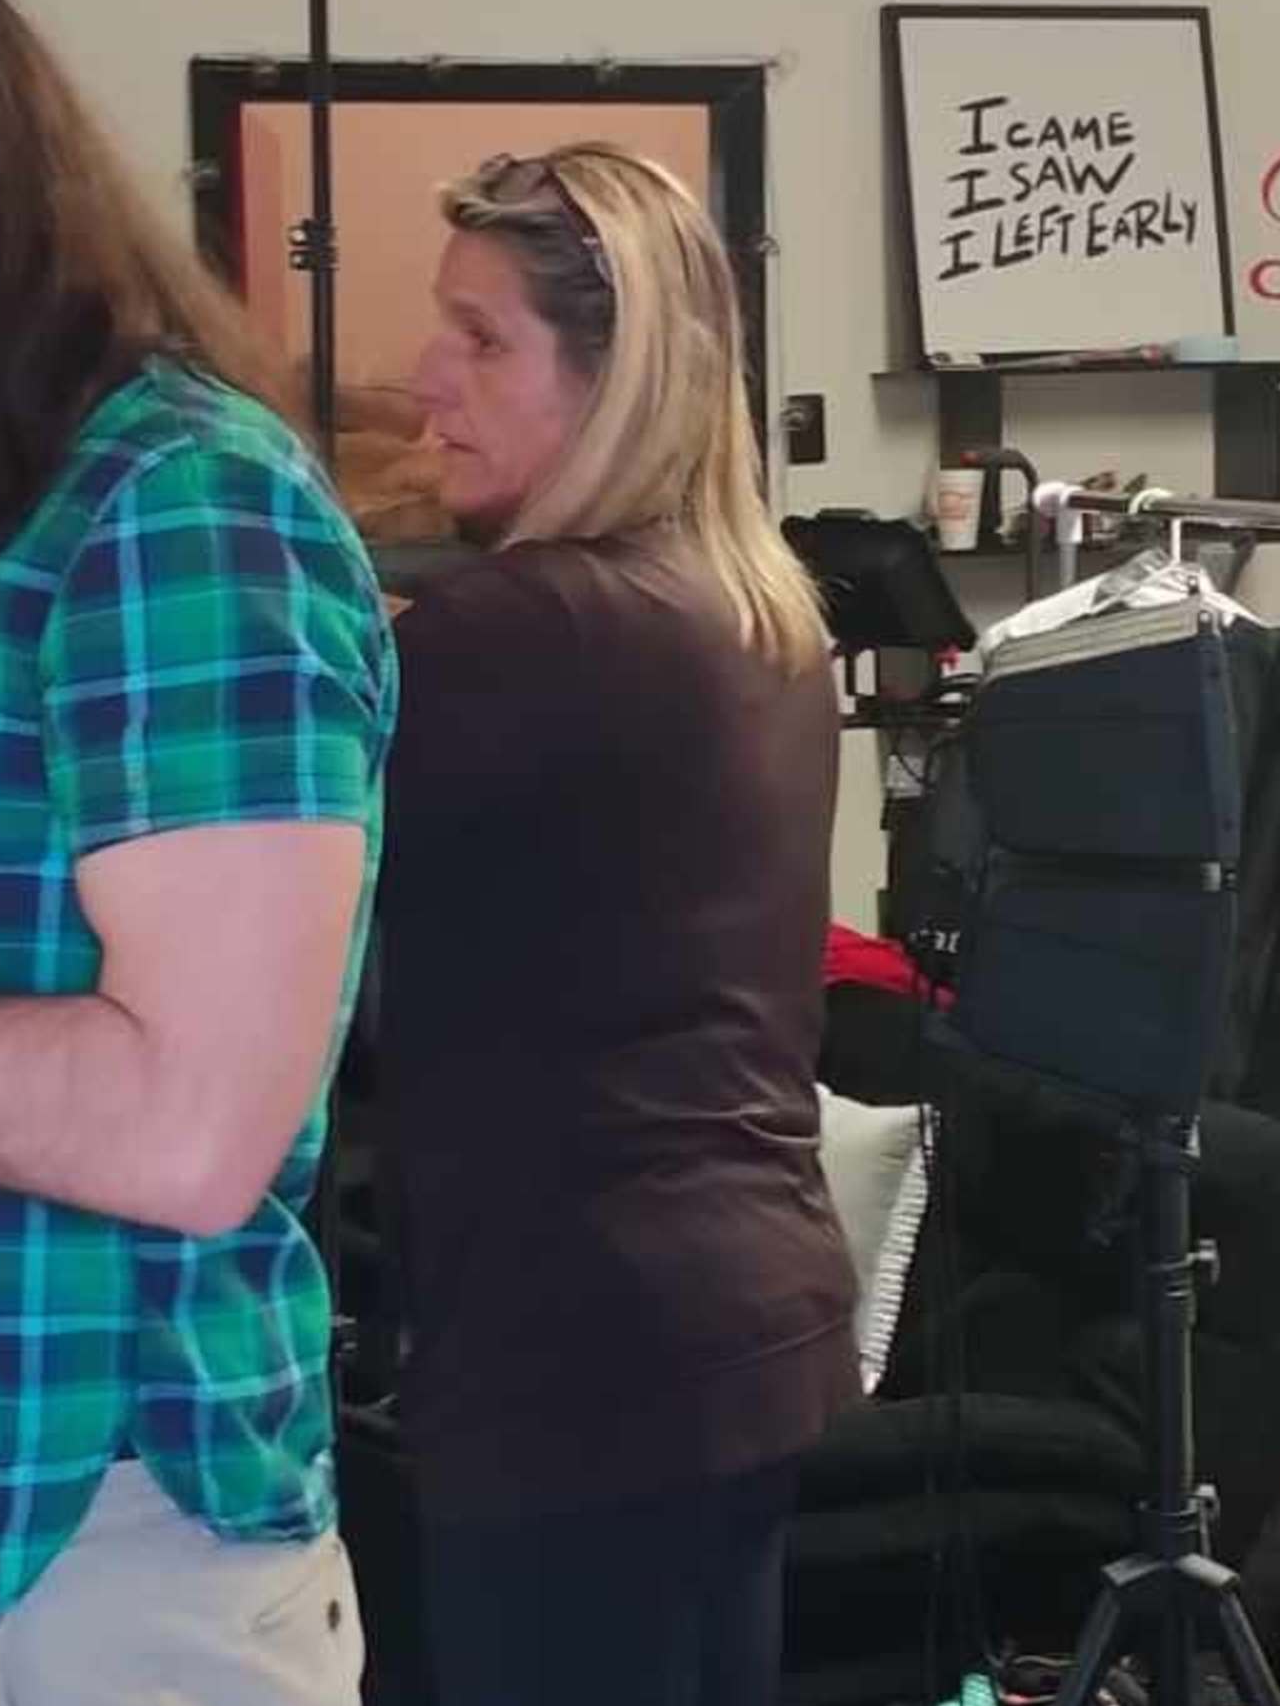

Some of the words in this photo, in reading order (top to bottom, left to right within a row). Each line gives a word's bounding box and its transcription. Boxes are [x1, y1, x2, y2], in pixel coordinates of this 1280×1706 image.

[959, 96, 1009, 155] I
[1006, 111, 1135, 151] CAME
[946, 168, 1005, 218] I
[1009, 152, 1135, 202] SAW
[938, 230, 981, 281] I
[993, 204, 1075, 268] LEFT
[1085, 193, 1198, 257] EARLY
